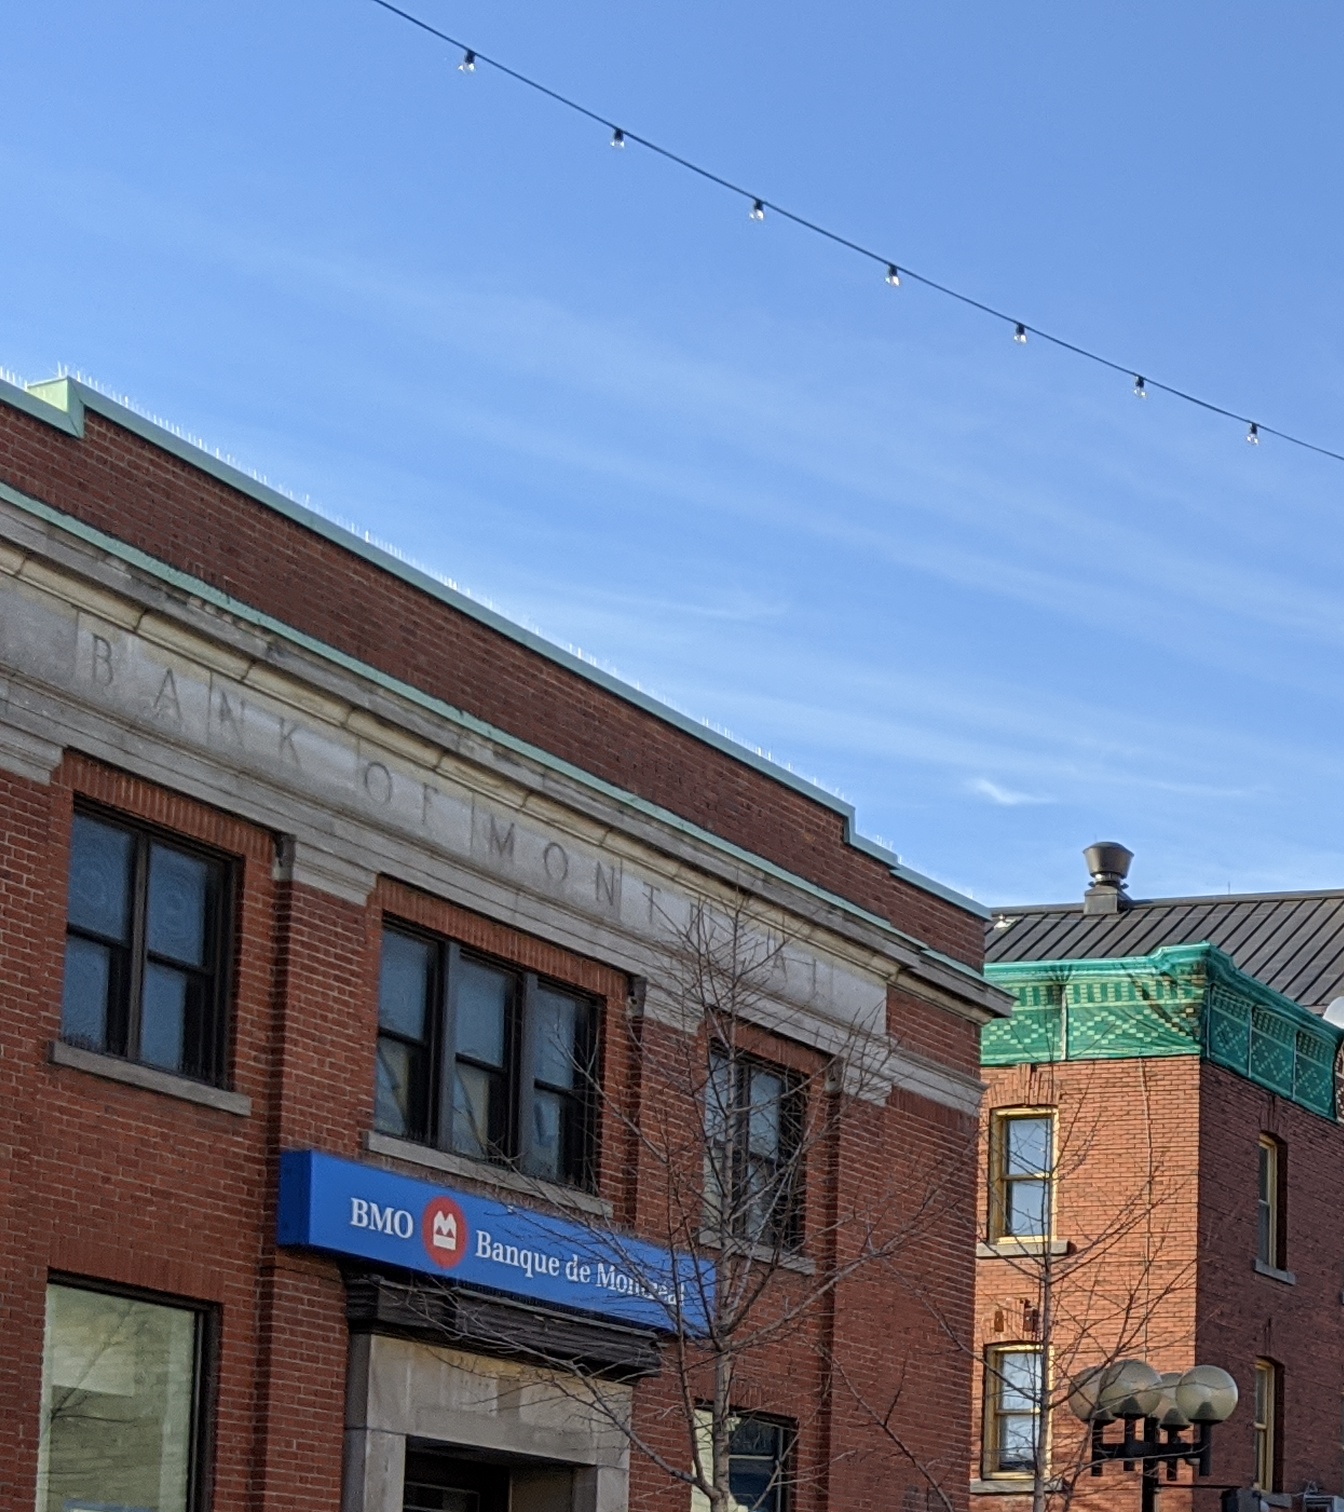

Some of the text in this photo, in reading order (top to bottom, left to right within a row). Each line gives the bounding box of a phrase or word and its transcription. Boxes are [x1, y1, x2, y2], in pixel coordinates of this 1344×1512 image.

[91, 633, 828, 1000] BANK OF MONTRAL
[350, 1197, 414, 1239] BMO
[474, 1229, 559, 1278] Banque
[564, 1253, 592, 1284] de
